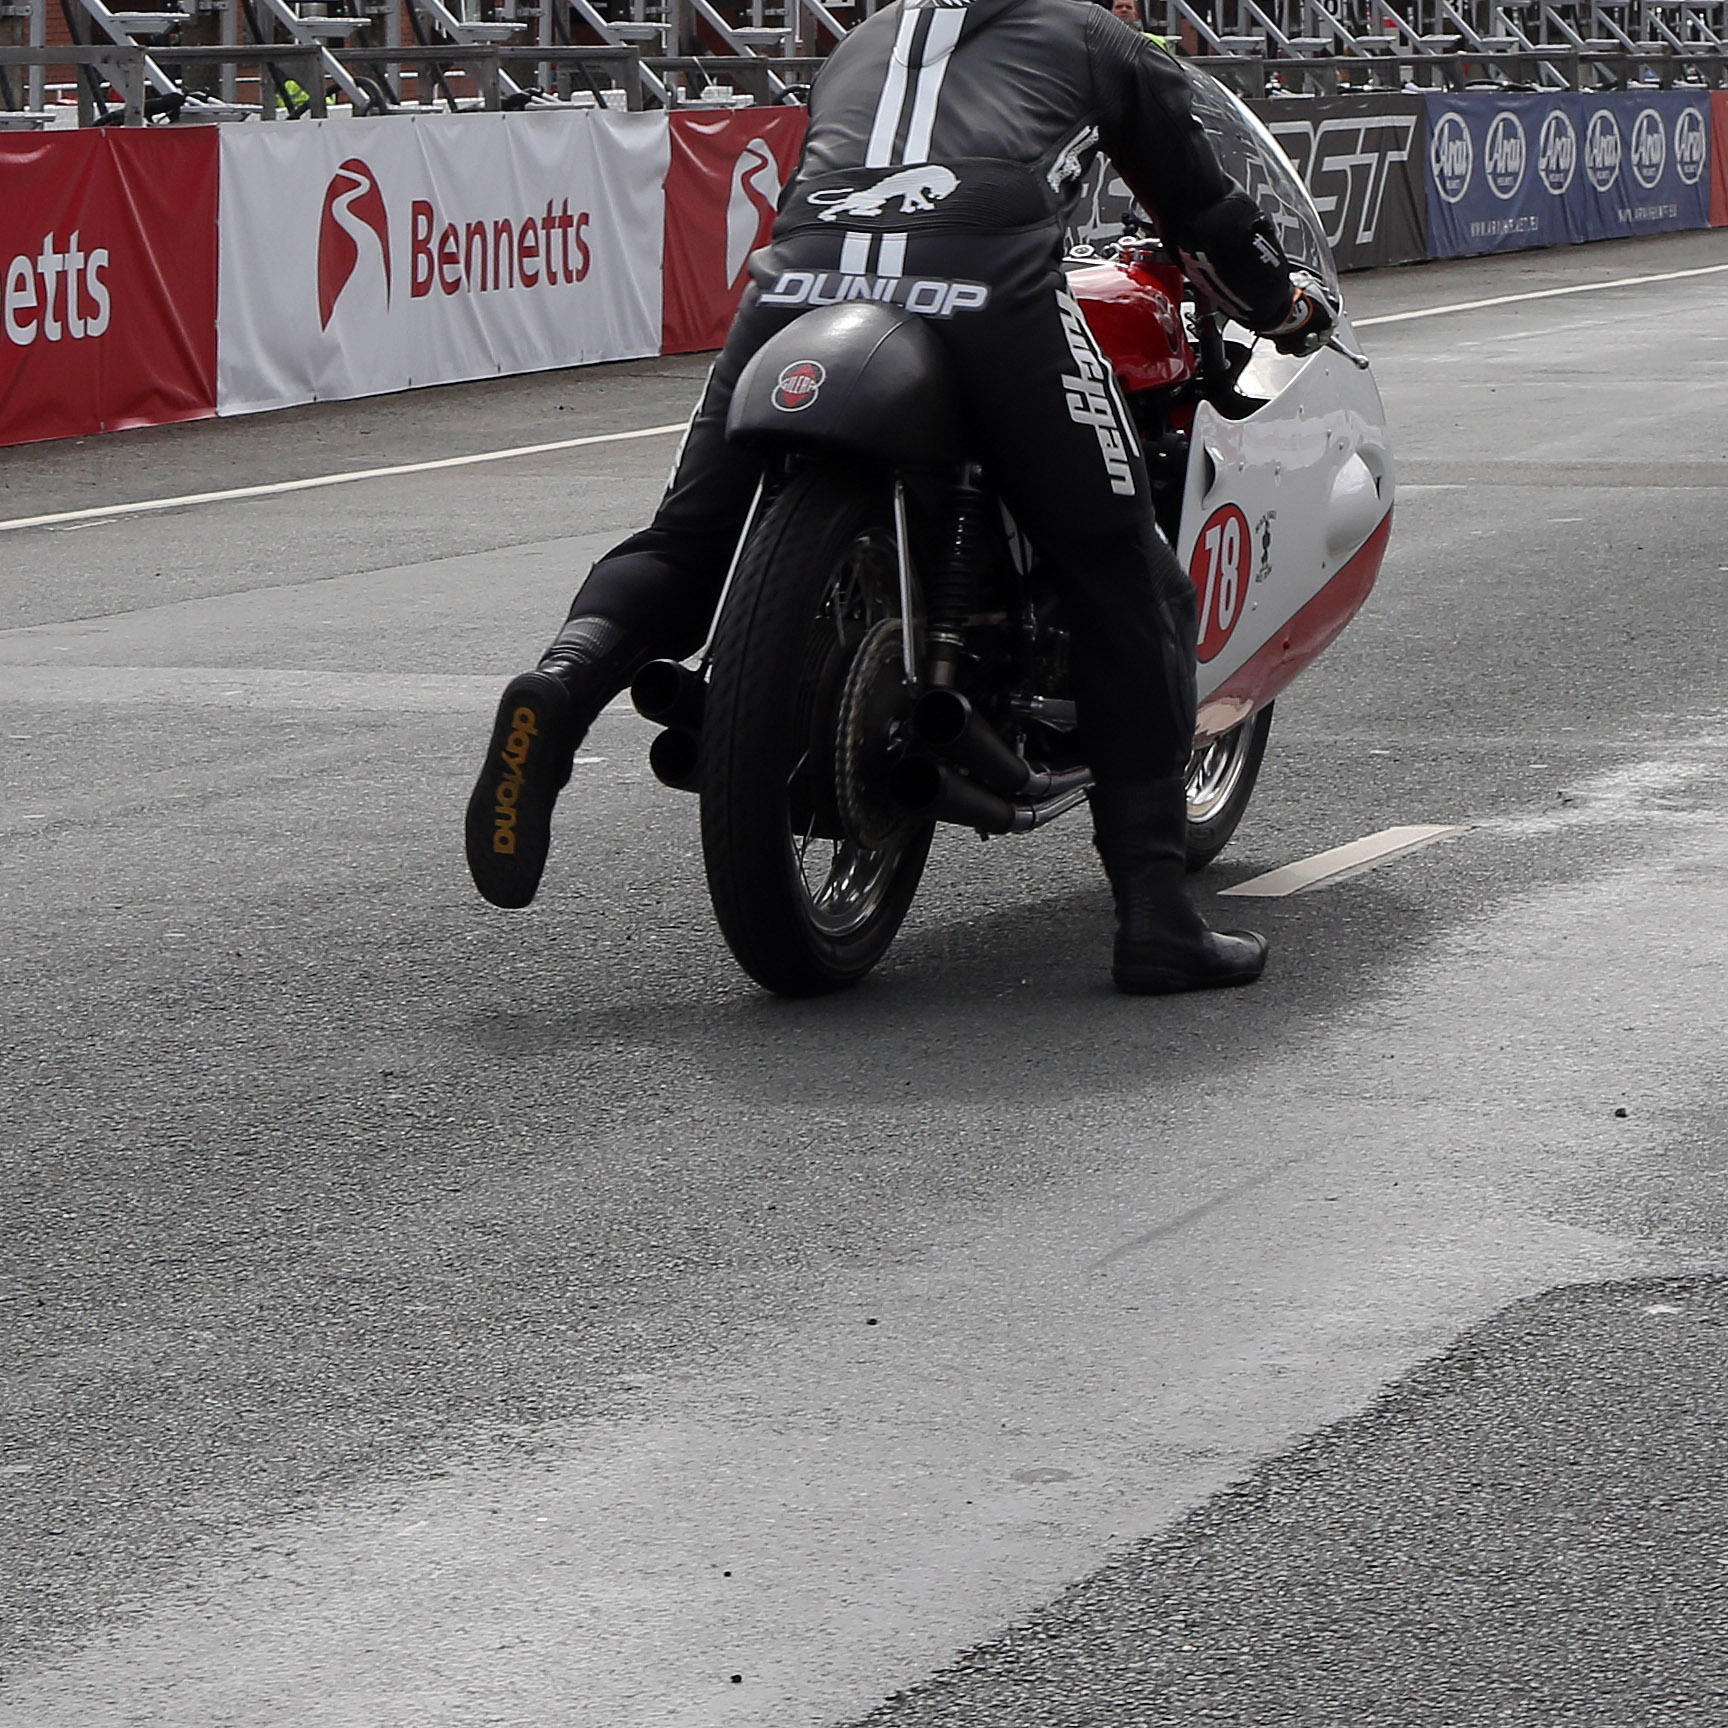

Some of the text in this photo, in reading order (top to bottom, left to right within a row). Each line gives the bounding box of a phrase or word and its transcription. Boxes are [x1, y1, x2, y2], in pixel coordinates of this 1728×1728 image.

[411, 196, 590, 299] Bennetts
[759, 271, 989, 315] DUNLOP
[1197, 517, 1241, 646] 78
[492, 706, 539, 854] daytona
